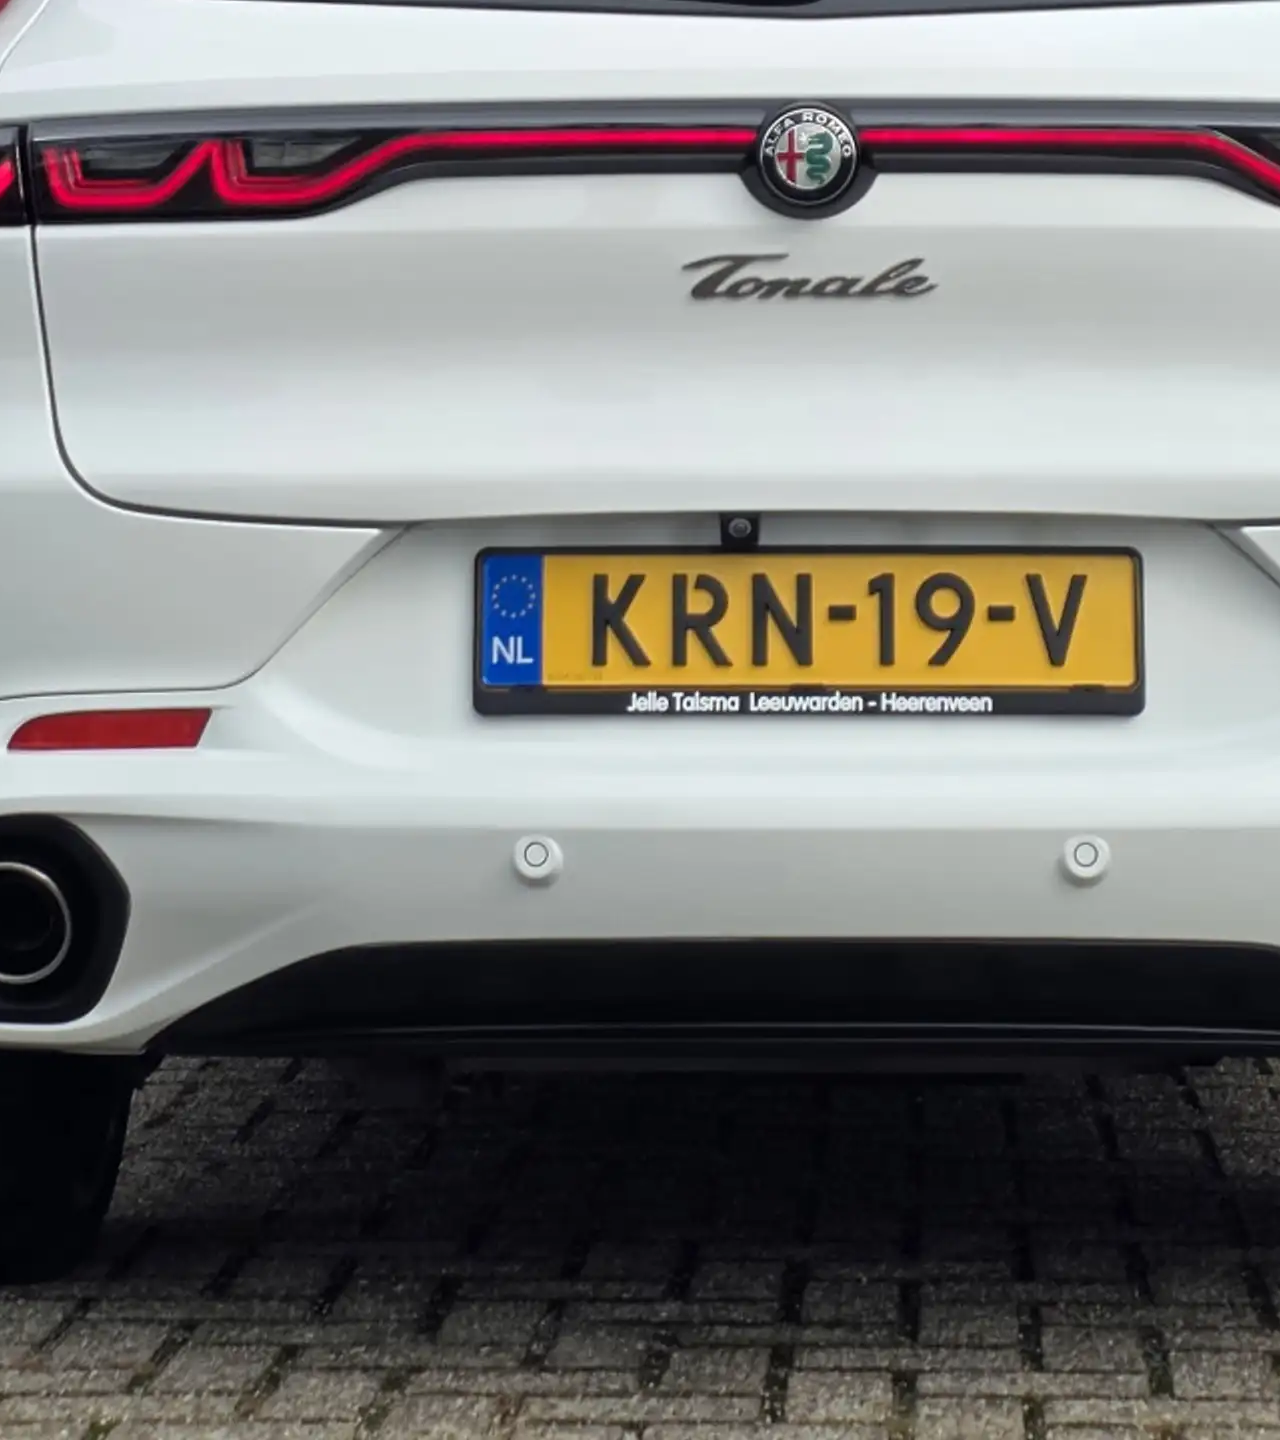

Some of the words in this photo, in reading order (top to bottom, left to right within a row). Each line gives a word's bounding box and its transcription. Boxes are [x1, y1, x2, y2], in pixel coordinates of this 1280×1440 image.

[765, 118, 795, 157] ALFA
[802, 112, 852, 157] ROMEO
[681, 253, 939, 300] Tonale
[592, 572, 1088, 667] KRN-19-V
[492, 635, 534, 664] NL
[627, 690, 669, 712] Jelle
[672, 690, 740, 712] Talsma
[749, 690, 863, 712] Leeuwarden
[881, 691, 993, 712] Heerenveen
